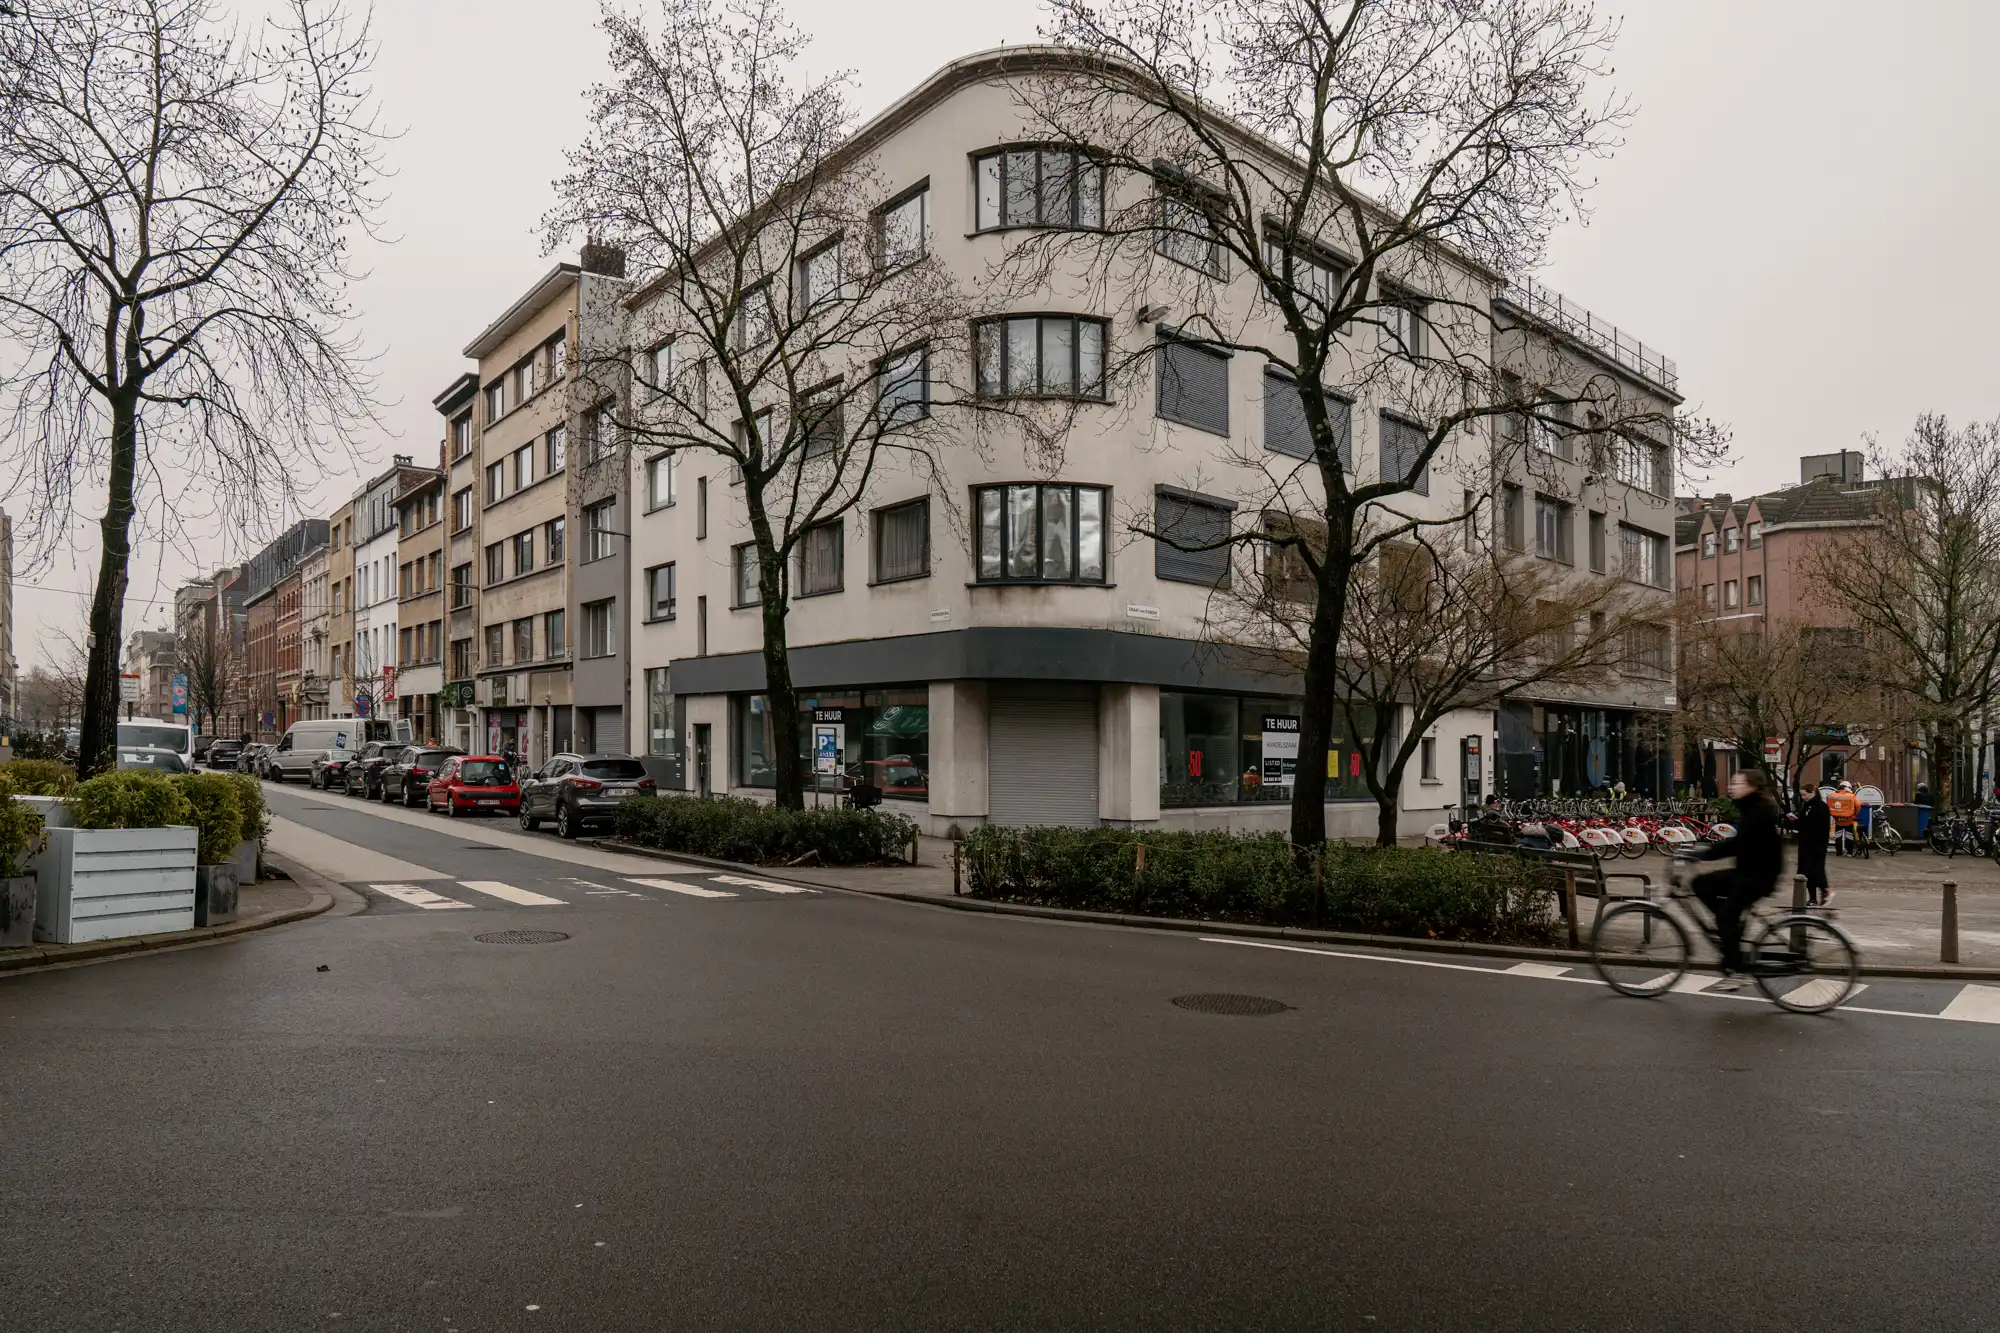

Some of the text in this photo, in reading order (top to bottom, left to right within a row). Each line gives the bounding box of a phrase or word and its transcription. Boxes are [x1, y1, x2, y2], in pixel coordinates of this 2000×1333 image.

[815, 711, 842, 721] TE HUUR
[1265, 718, 1298, 730] TE HUUR
[818, 735, 828, 750] P
